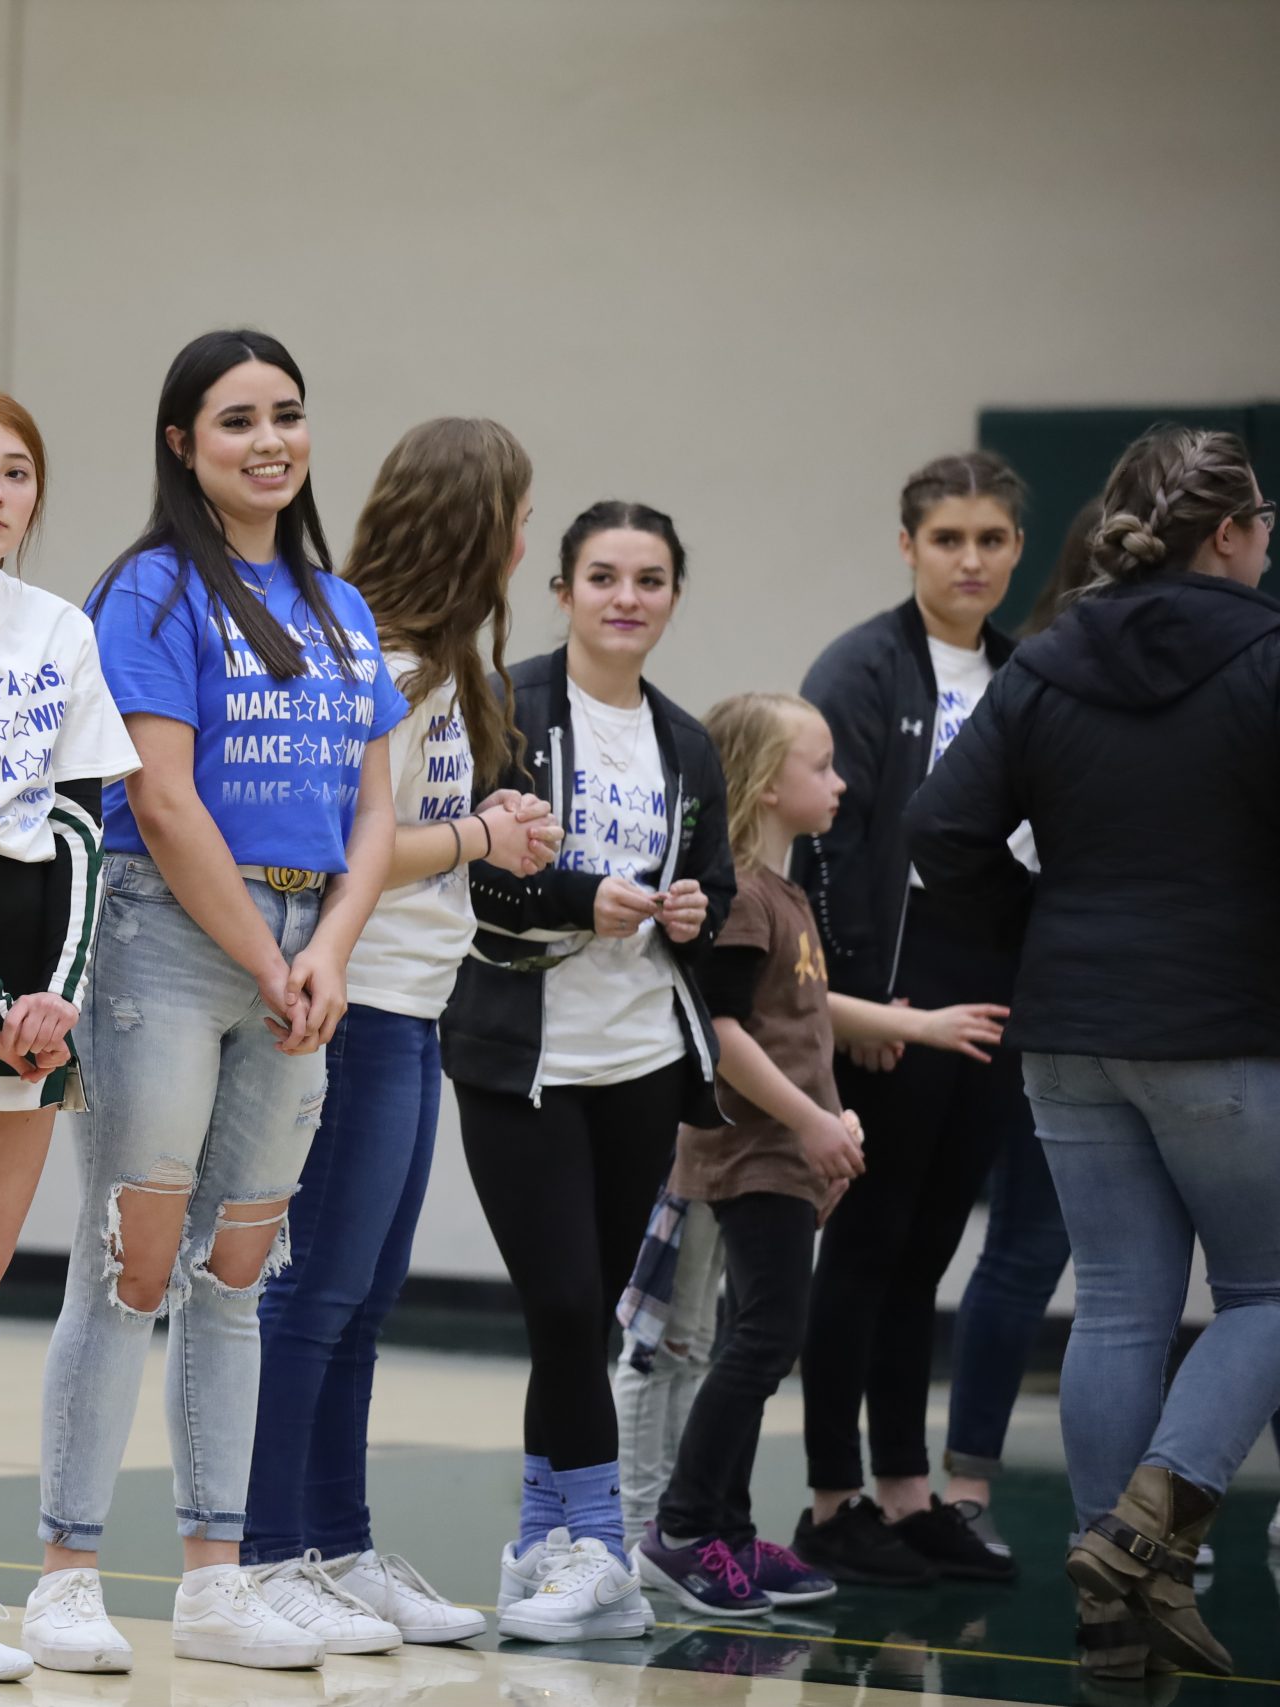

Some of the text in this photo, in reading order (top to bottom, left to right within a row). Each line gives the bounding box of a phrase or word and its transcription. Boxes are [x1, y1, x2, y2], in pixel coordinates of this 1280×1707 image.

[224, 650, 267, 678] MA
[305, 656, 323, 679] A
[8, 670, 22, 697] A
[28, 700, 67, 733] WIS
[226, 691, 291, 721] MAKE
[317, 693, 331, 721] A
[224, 735, 291, 764] MAKE
[320, 737, 332, 764] A
[1, 755, 18, 782] A
[222, 781, 291, 807] MAKE
[322, 782, 332, 806] A
[609, 783, 621, 806] A
[604, 819, 618, 845] A
